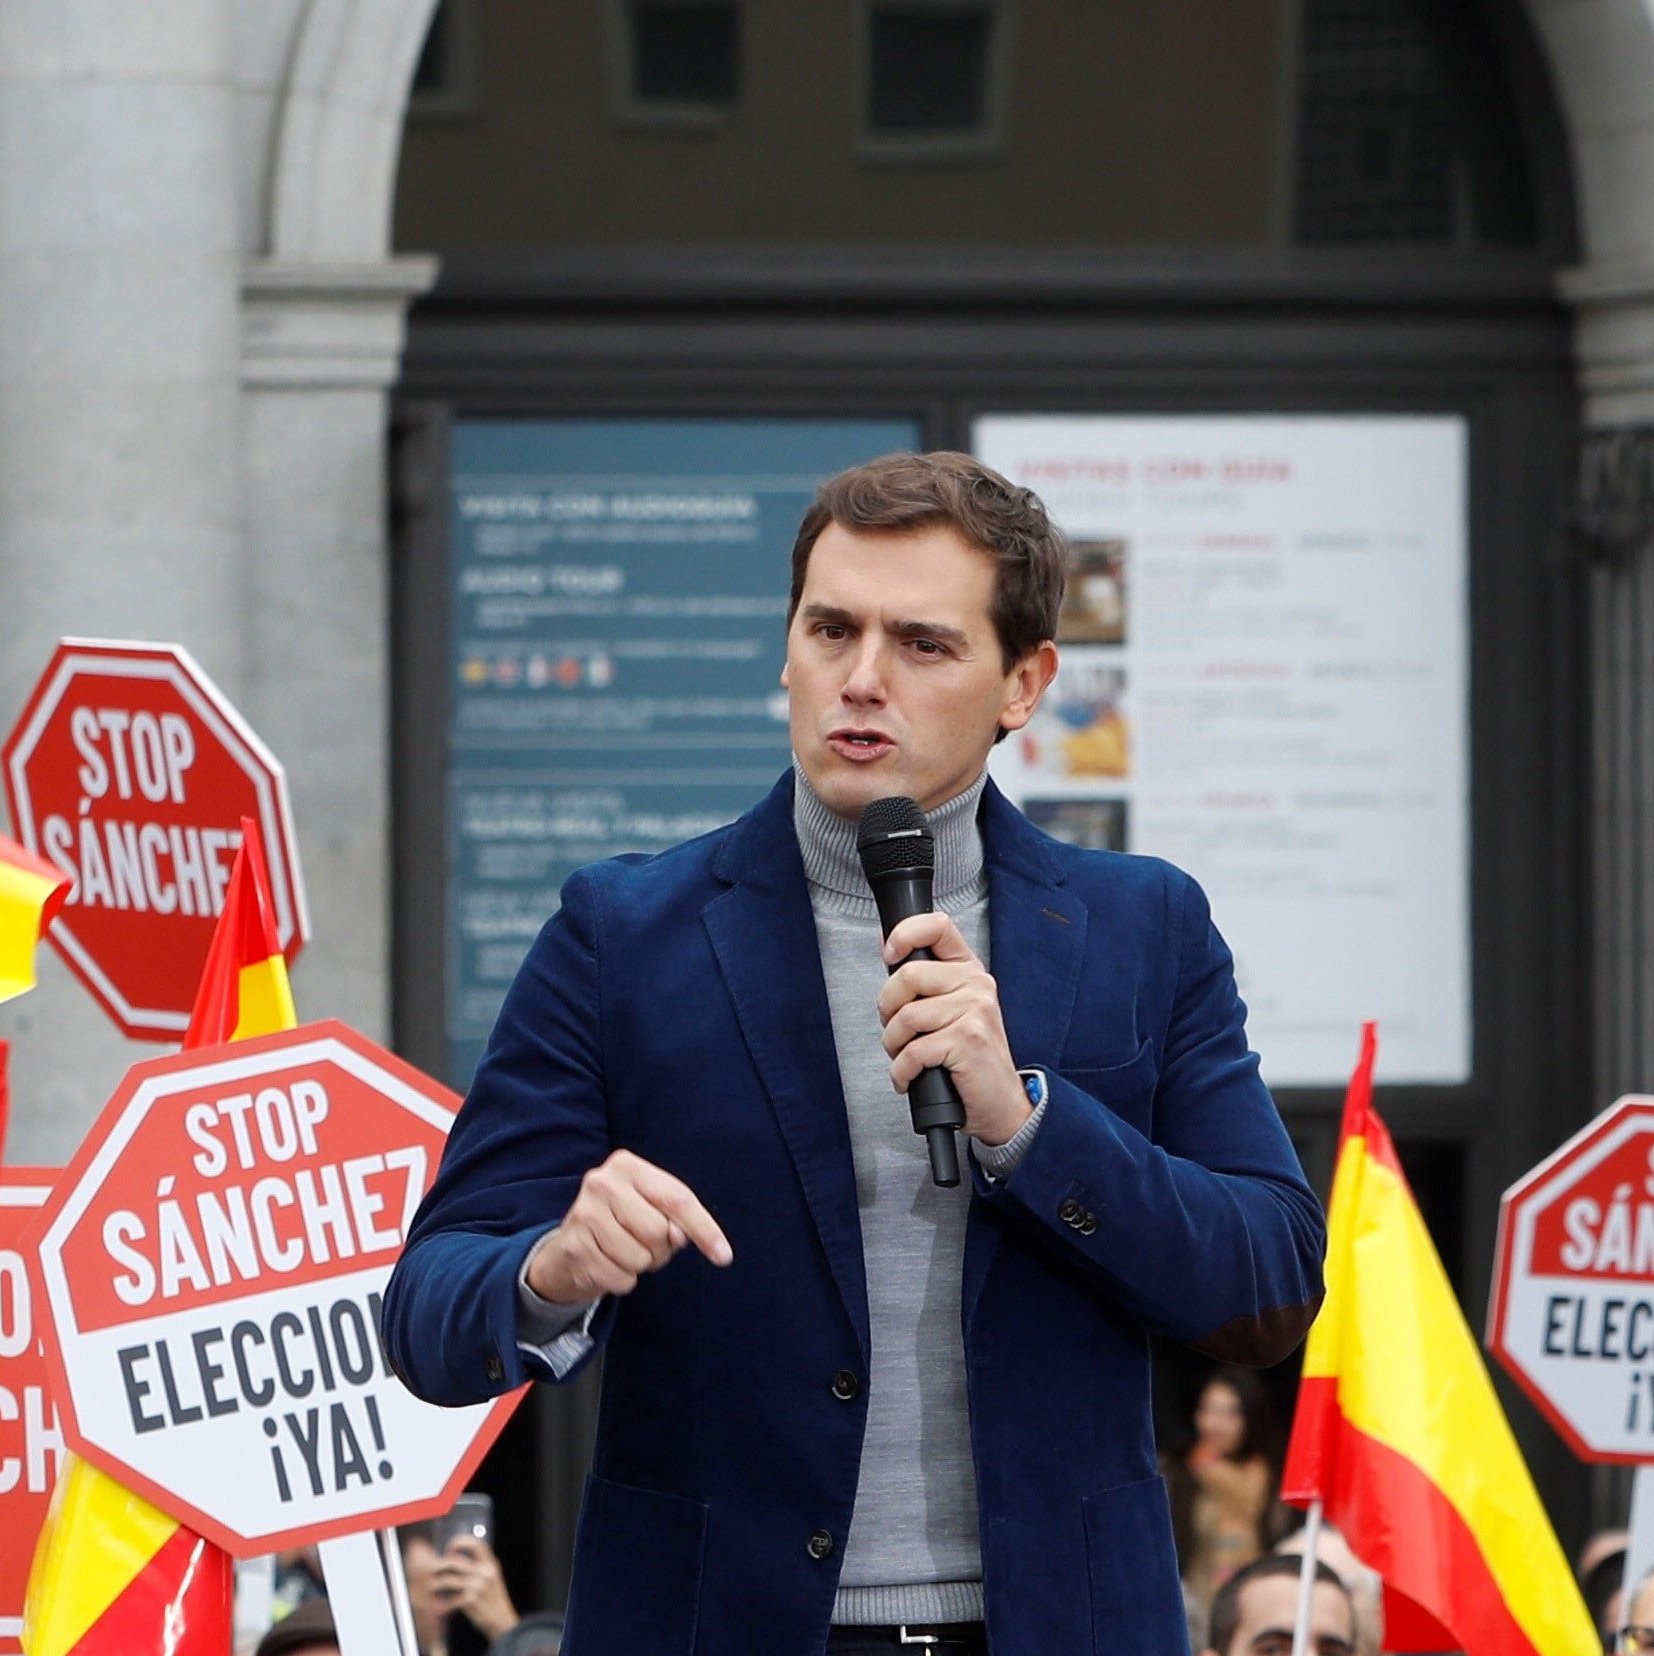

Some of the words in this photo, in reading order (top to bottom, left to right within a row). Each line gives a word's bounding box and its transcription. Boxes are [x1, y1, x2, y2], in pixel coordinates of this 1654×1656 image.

[70, 706, 196, 803] STOP
[42, 798, 245, 918] SÁNCHE
[184, 1079, 330, 1178] STOP
[101, 1144, 429, 1306] SÁNCHEZ
[261, 1395, 395, 1503] ¡YA!
